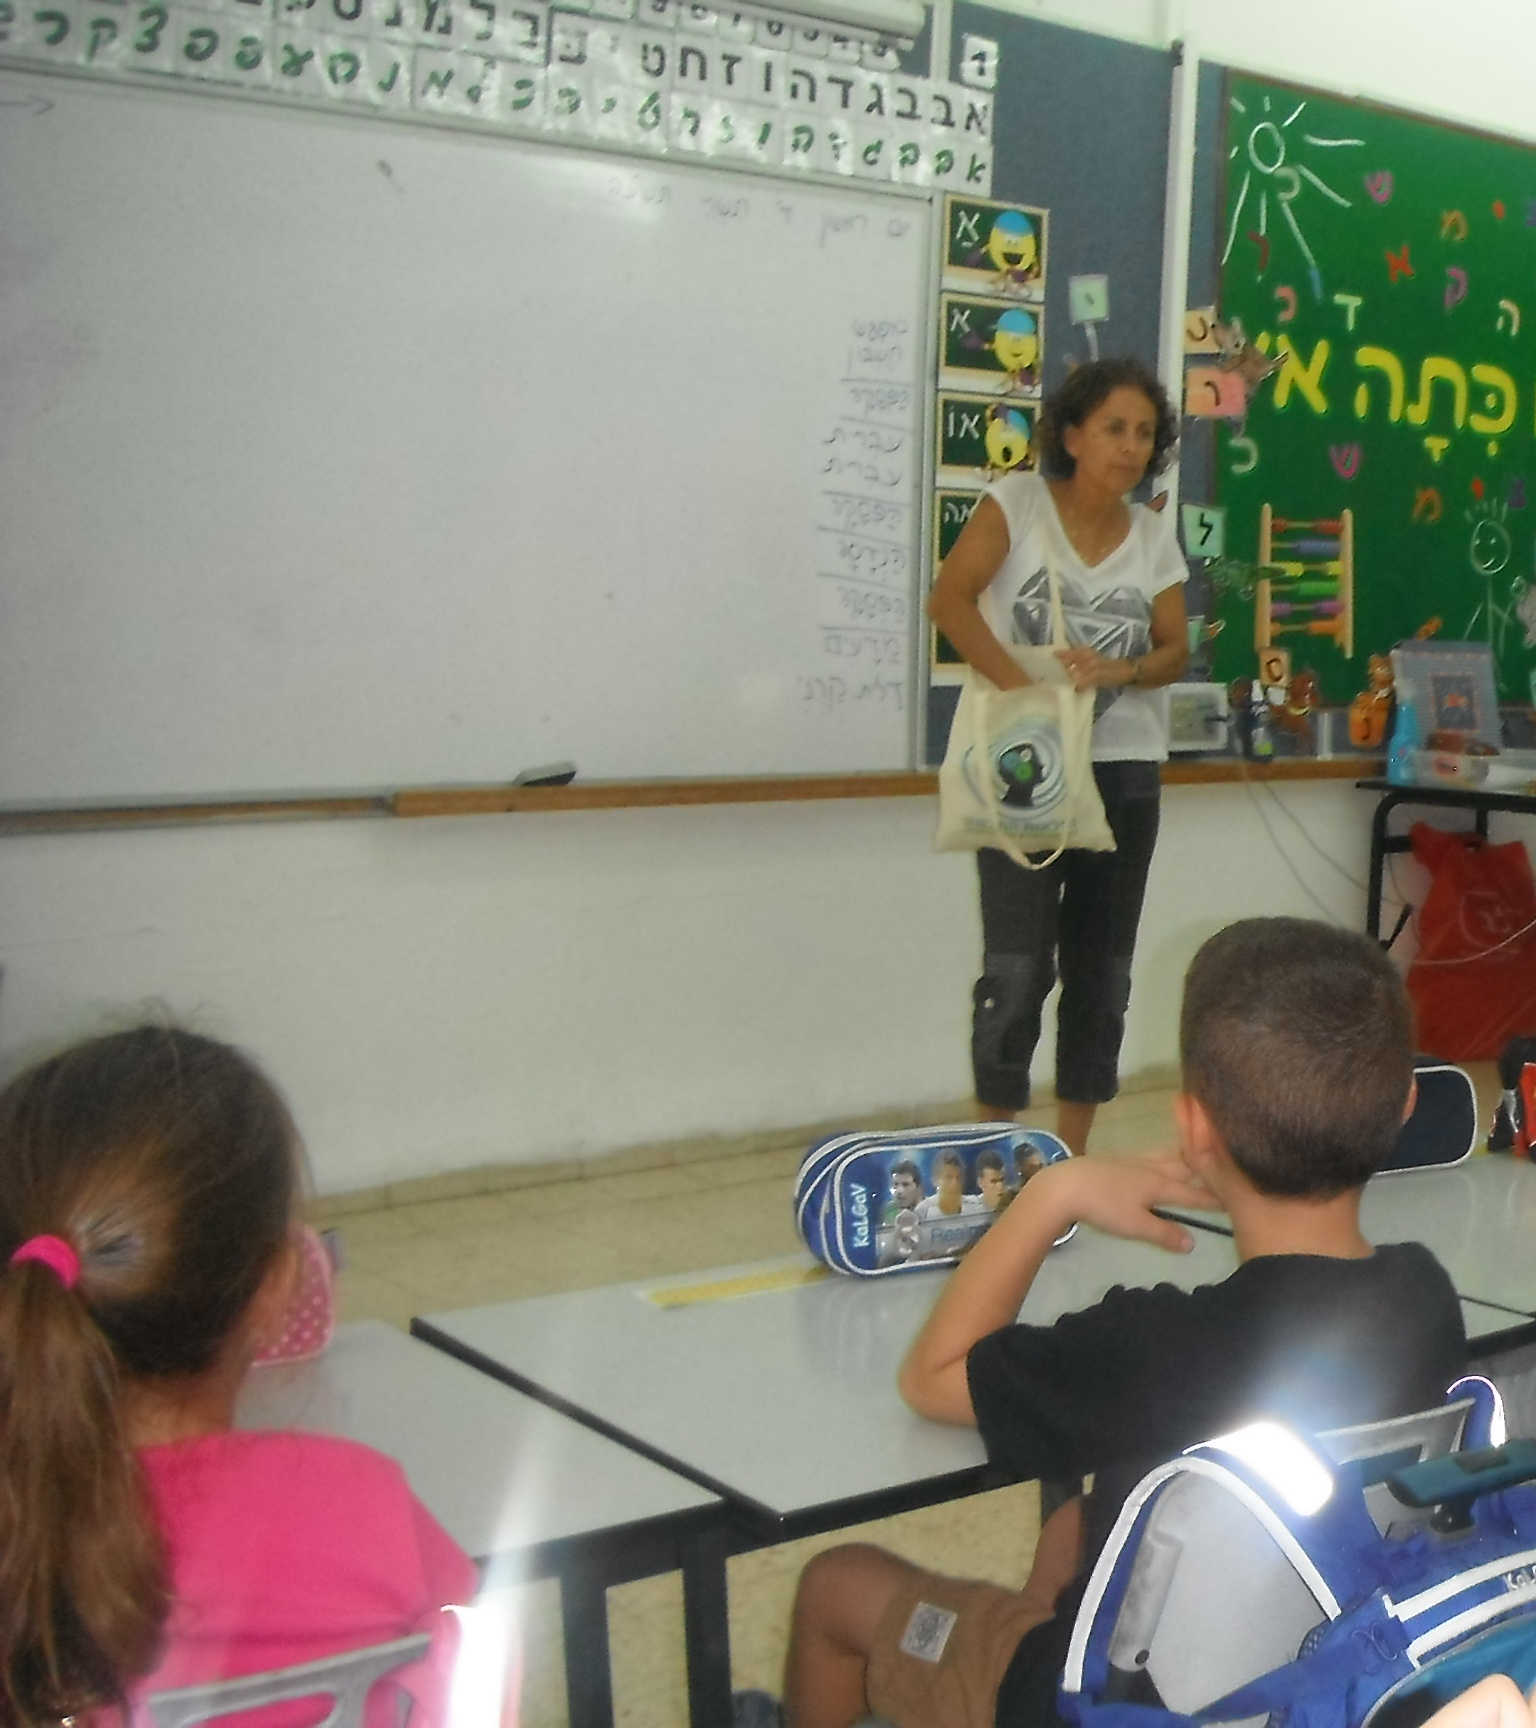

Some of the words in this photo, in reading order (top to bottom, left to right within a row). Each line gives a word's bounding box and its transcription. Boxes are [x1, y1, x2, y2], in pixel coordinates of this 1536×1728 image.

[1364, 169, 1394, 204] ש
[1385, 244, 1415, 284] א
[1333, 293, 1362, 331] ד
[1497, 299, 1520, 337] ה
[1329, 442, 1361, 480] ש
[1199, 512, 1214, 547] ל
